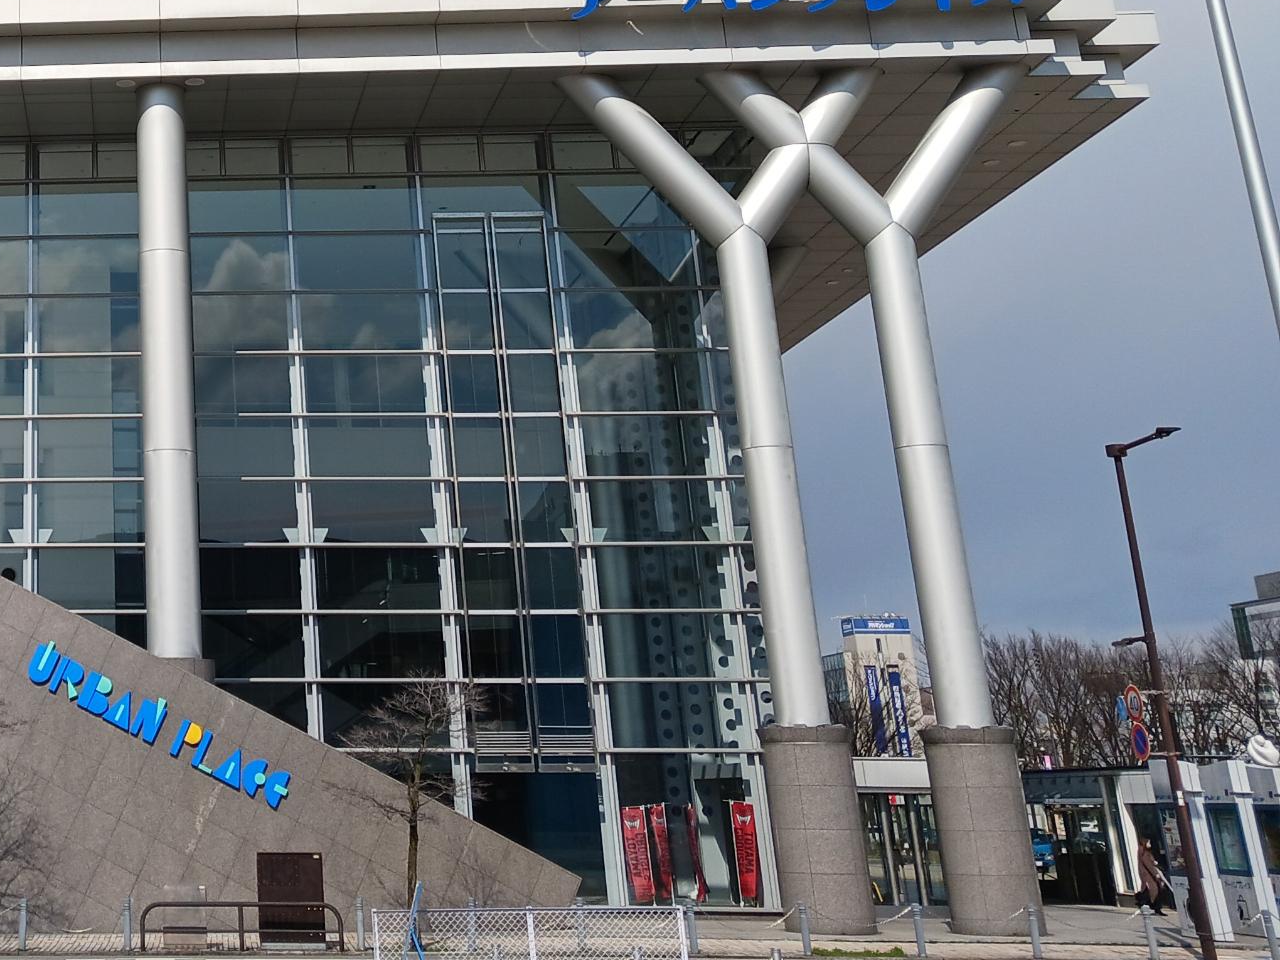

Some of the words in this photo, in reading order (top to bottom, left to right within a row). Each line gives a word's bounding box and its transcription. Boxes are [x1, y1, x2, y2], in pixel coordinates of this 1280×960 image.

[28, 640, 169, 745] URBAN
[170, 718, 291, 809] PLACE
[744, 831, 755, 874] TOYAMA
